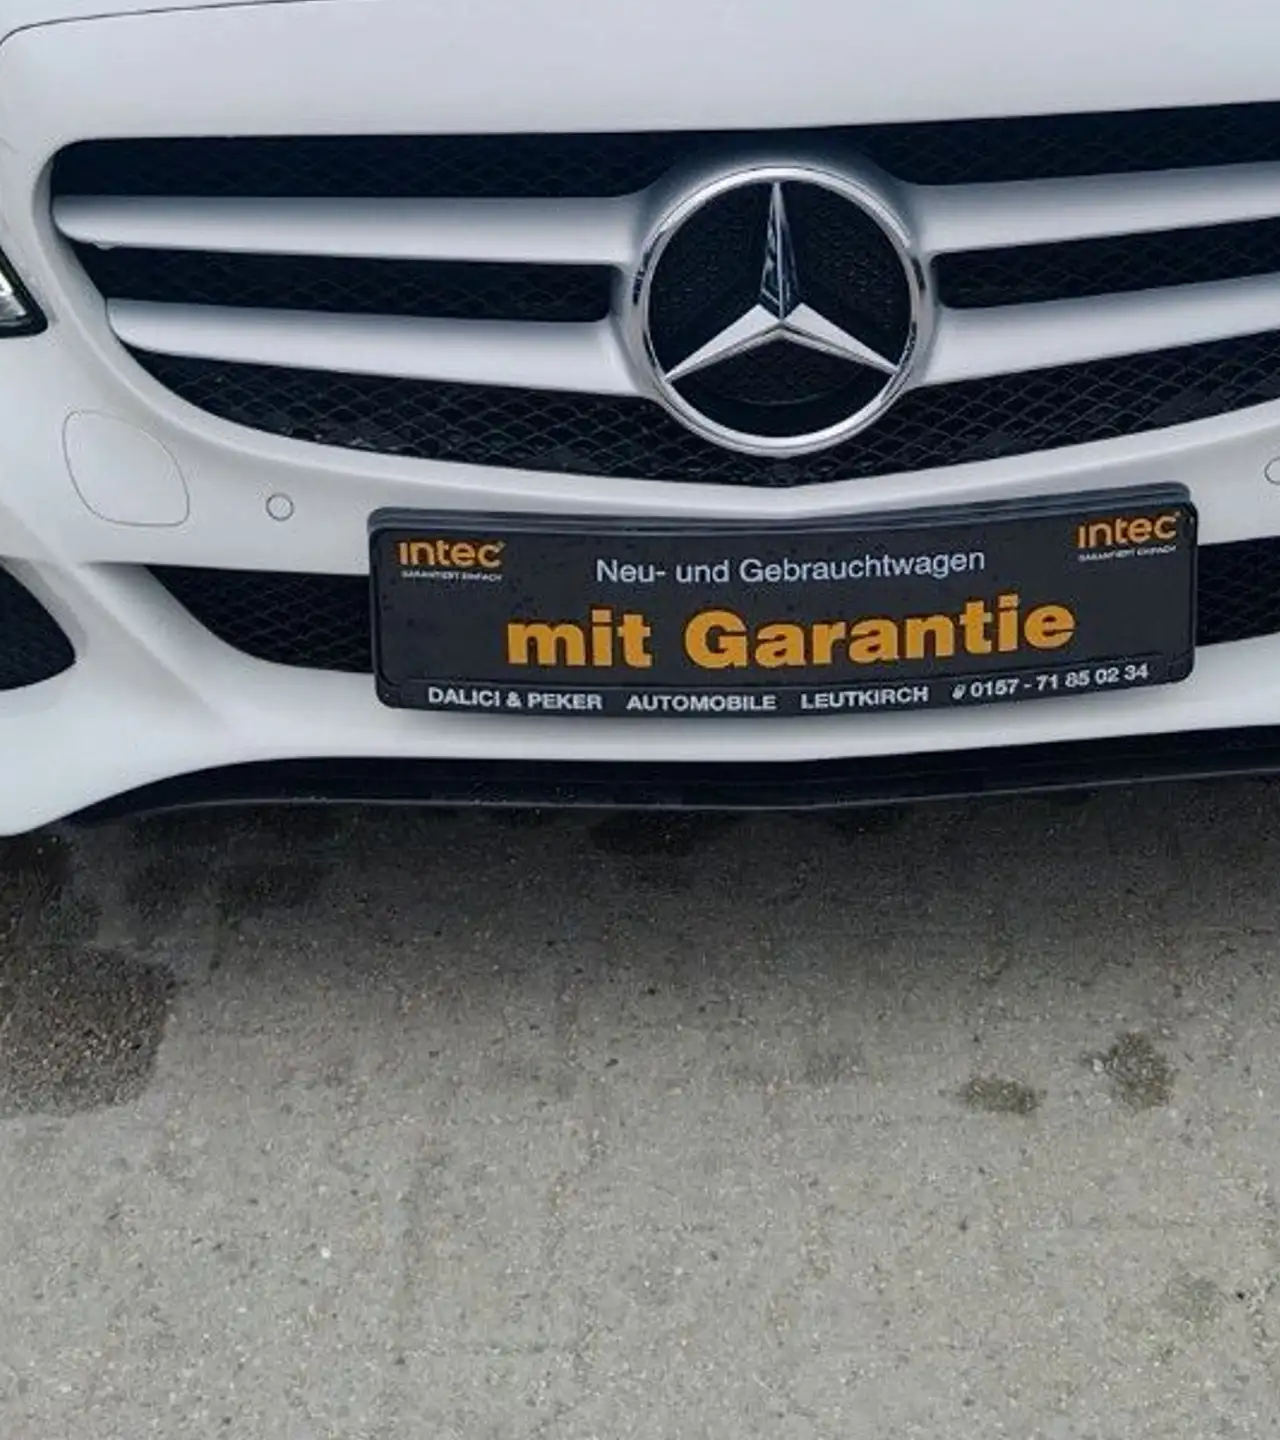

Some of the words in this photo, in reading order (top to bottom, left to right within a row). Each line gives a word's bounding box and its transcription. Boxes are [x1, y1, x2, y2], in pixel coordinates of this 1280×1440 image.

[596, 559, 666, 583] Neu-
[675, 560, 730, 583] und
[739, 550, 985, 582] Gebrauchtwagen
[507, 608, 653, 668] mit
[684, 593, 1076, 669] Garantie
[428, 687, 500, 707] DALICI
[506, 690, 522, 708] &
[528, 693, 603, 710] PEKER
[626, 694, 776, 712] AUTOMOBILE
[801, 687, 929, 709] LEUTKIRCH
[971, 678, 1019, 698] 0157
[1037, 674, 1059, 690] 71
[1065, 670, 1090, 688] 85
[1095, 667, 1120, 684] 02
[1124, 663, 1149, 681] 34
